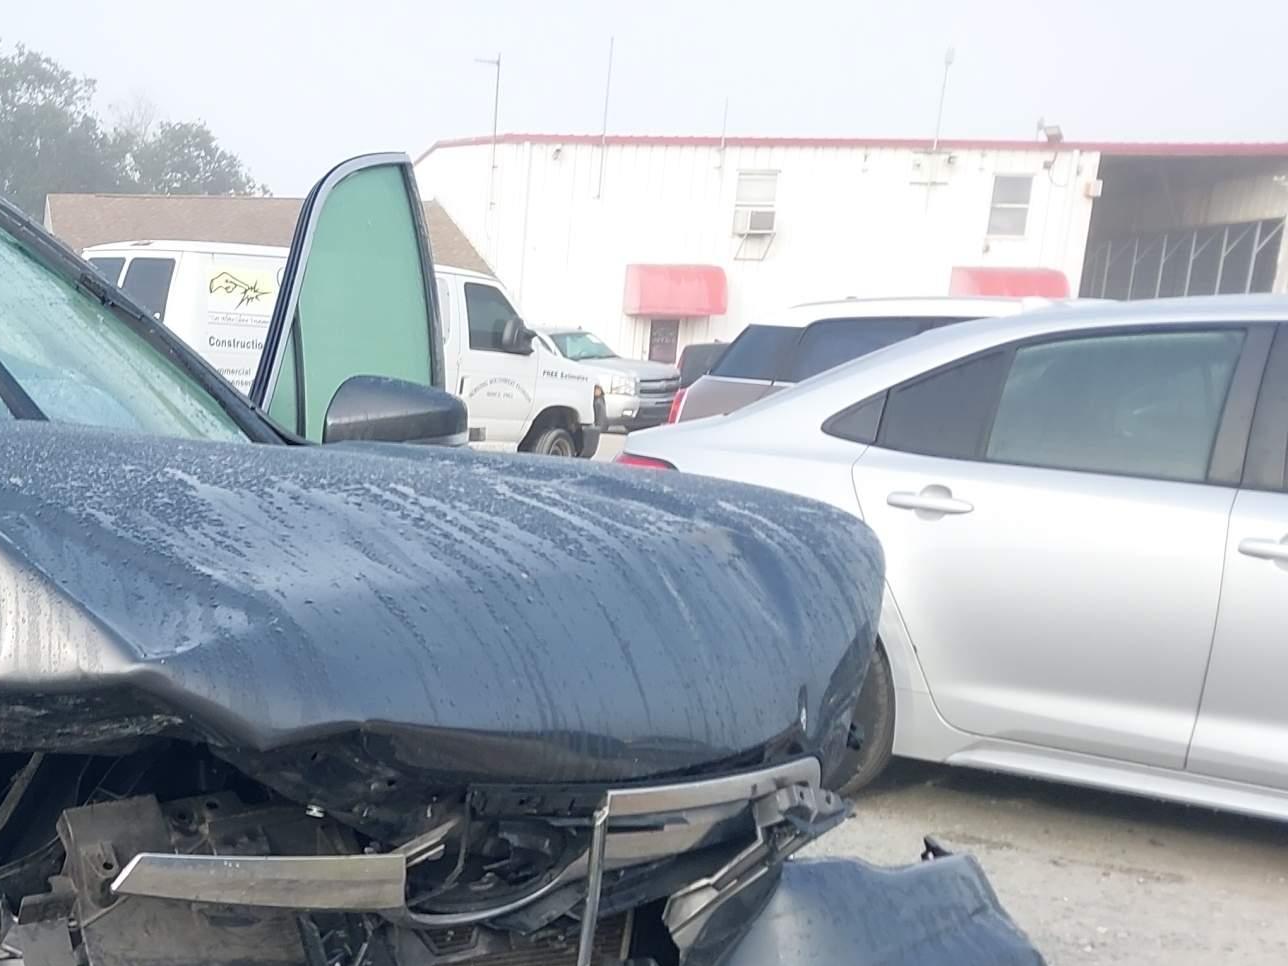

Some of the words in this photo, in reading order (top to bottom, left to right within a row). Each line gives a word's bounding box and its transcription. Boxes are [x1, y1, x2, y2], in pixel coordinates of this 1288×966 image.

[208, 336, 263, 350] Constructio
[215, 367, 252, 377] mmercial
[543, 369, 558, 378] FREE
